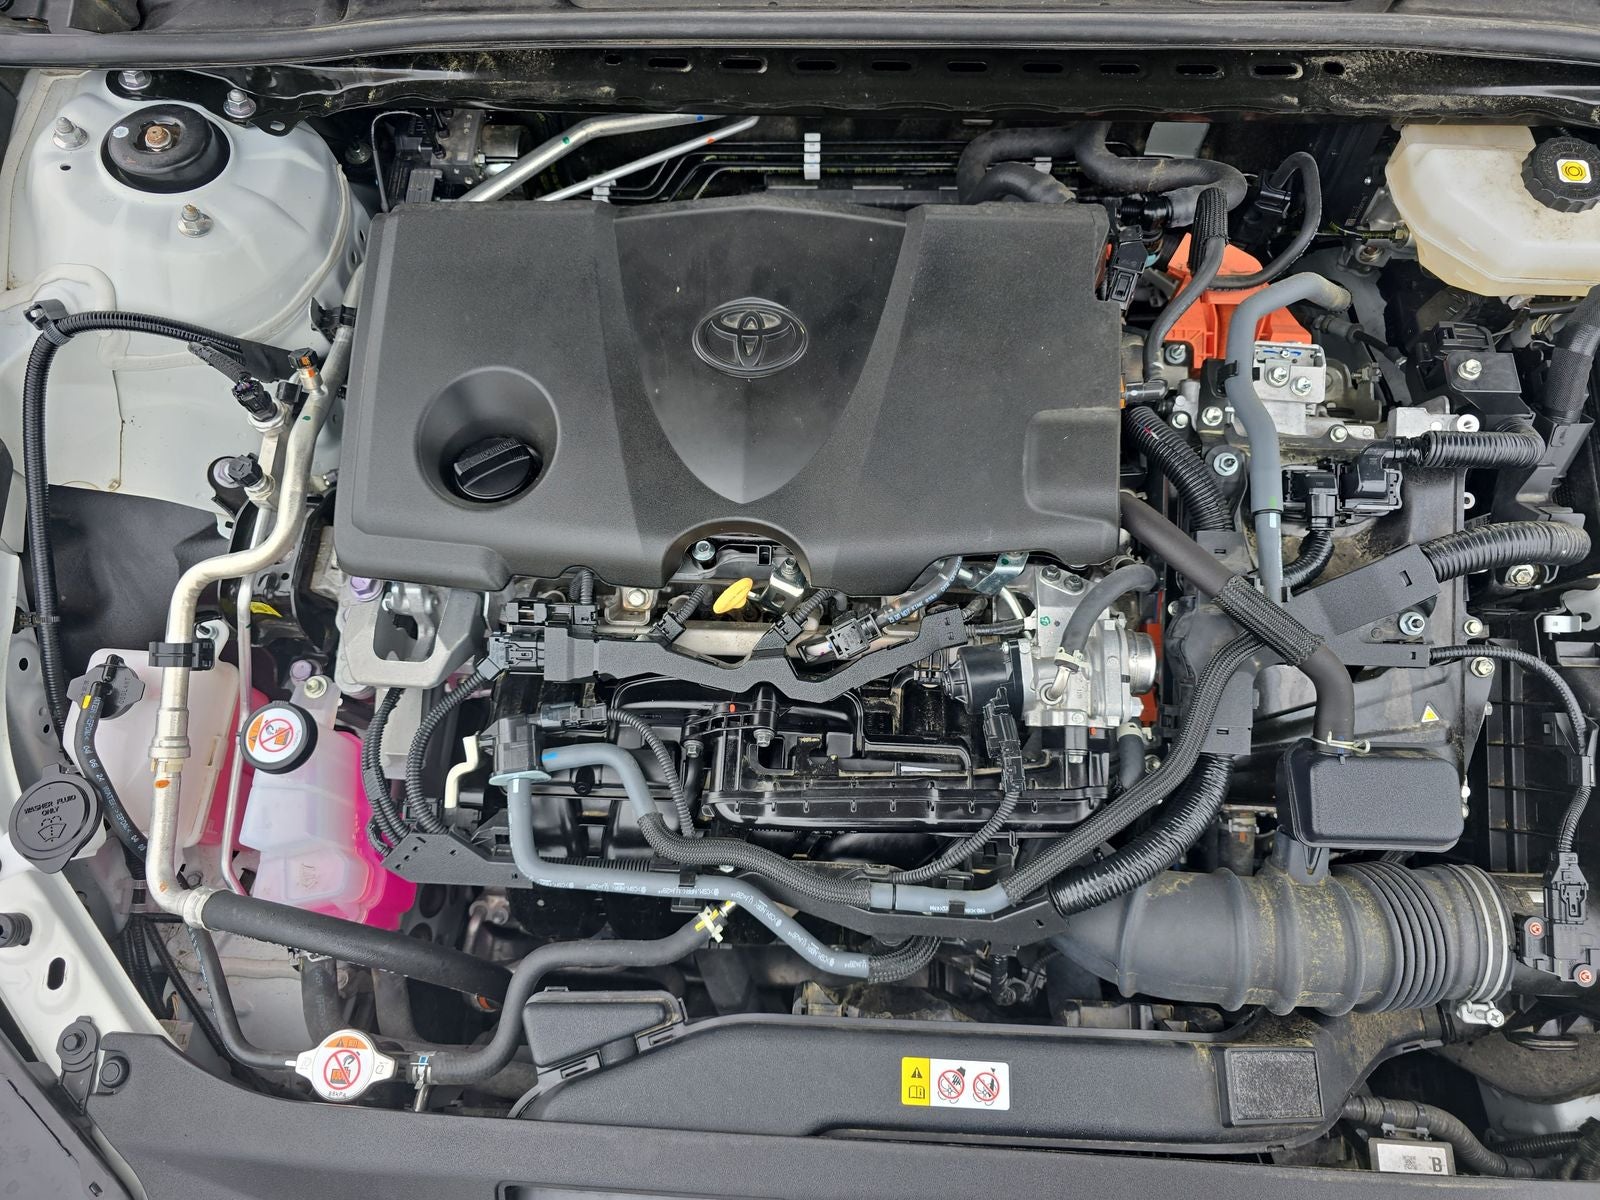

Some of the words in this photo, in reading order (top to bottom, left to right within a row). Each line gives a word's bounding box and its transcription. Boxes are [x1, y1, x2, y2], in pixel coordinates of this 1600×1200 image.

[24, 801, 53, 815] WASHER
[56, 795, 76, 805] FLUID
[41, 806, 60, 816] ONLY
[1432, 1157, 1442, 1172] B
